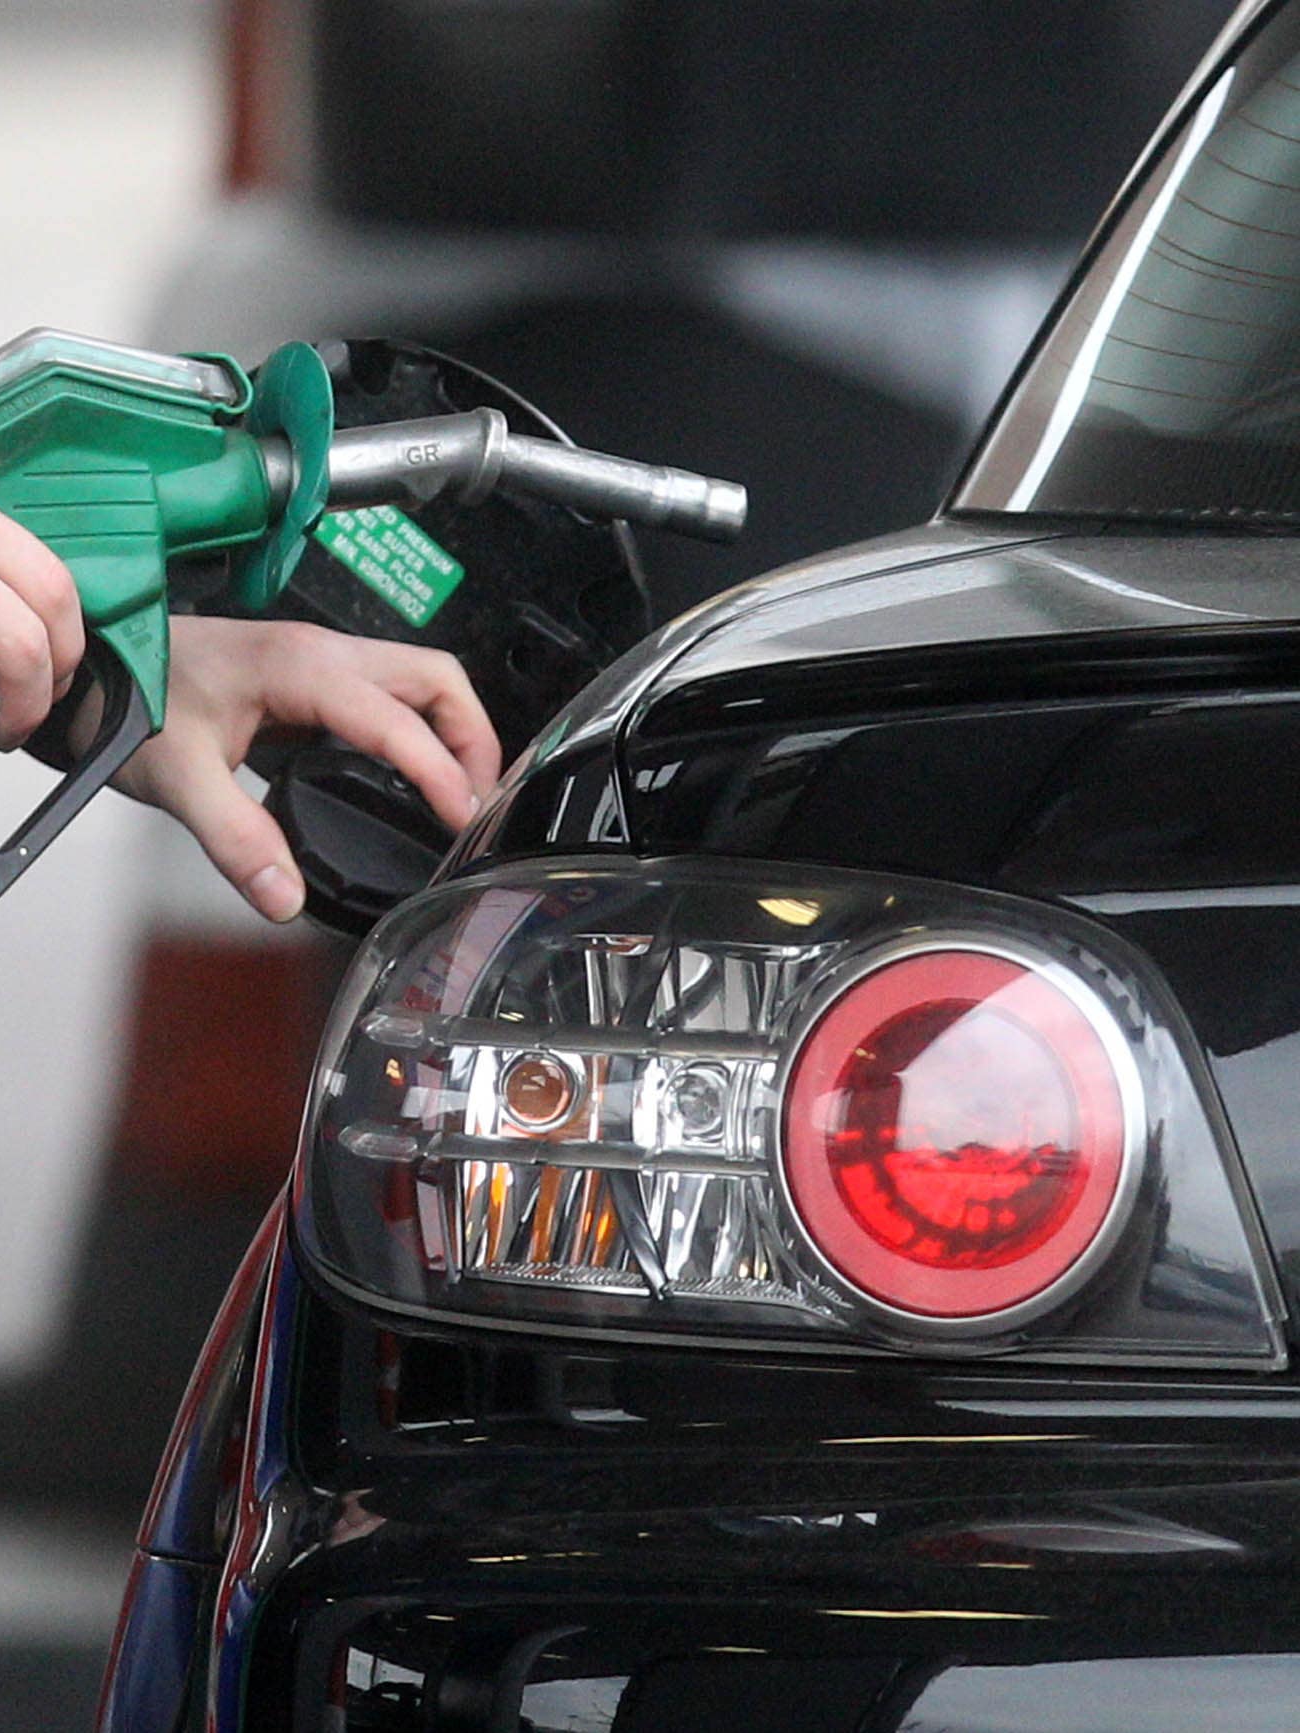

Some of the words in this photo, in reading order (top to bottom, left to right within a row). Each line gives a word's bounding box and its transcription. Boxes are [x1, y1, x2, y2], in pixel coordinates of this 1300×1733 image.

[406, 445, 440, 465] GR
[354, 528, 390, 562] SANS
[389, 559, 433, 601] PLOMB
[381, 529, 426, 571] SUPER
[396, 521, 454, 575] PREMIUM
